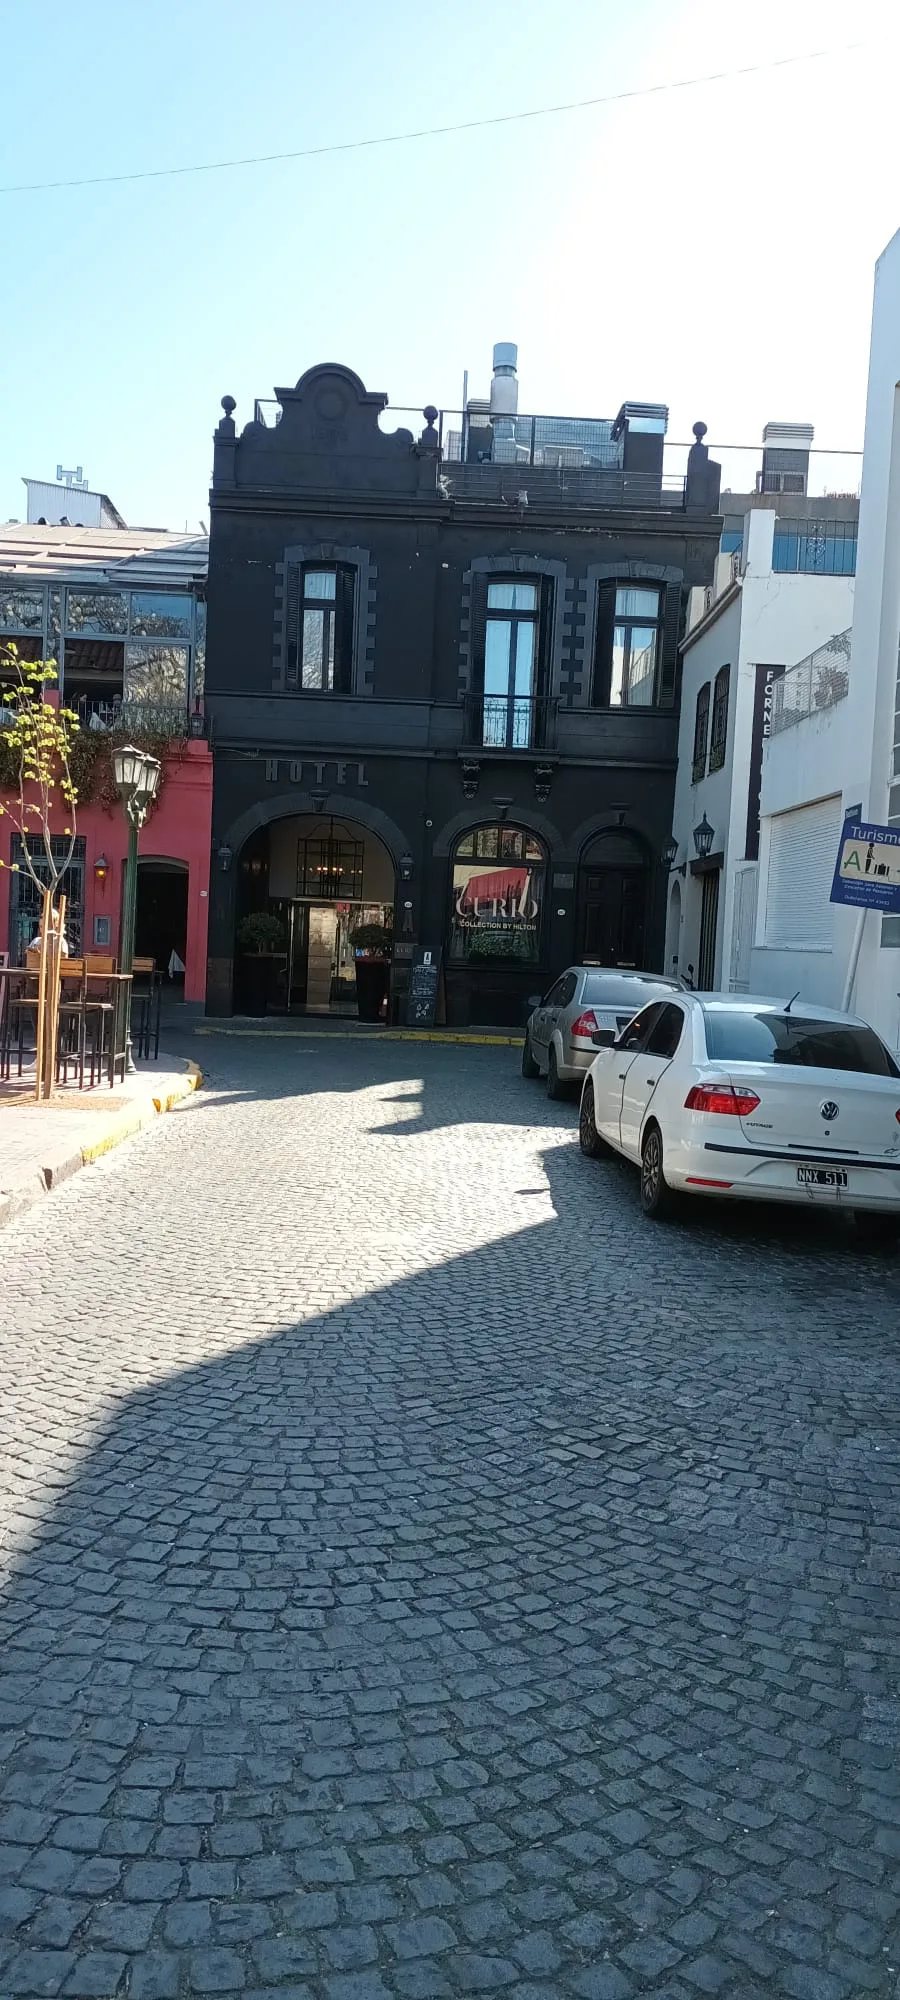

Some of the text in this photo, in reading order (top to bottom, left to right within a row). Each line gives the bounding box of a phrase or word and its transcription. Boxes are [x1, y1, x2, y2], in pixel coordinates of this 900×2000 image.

[265, 759, 369, 786] HOTEL
[455, 897, 538, 919] CURIO
[460, 920, 501, 929] COLLECTION
[798, 1168, 846, 1186] NNX 511
